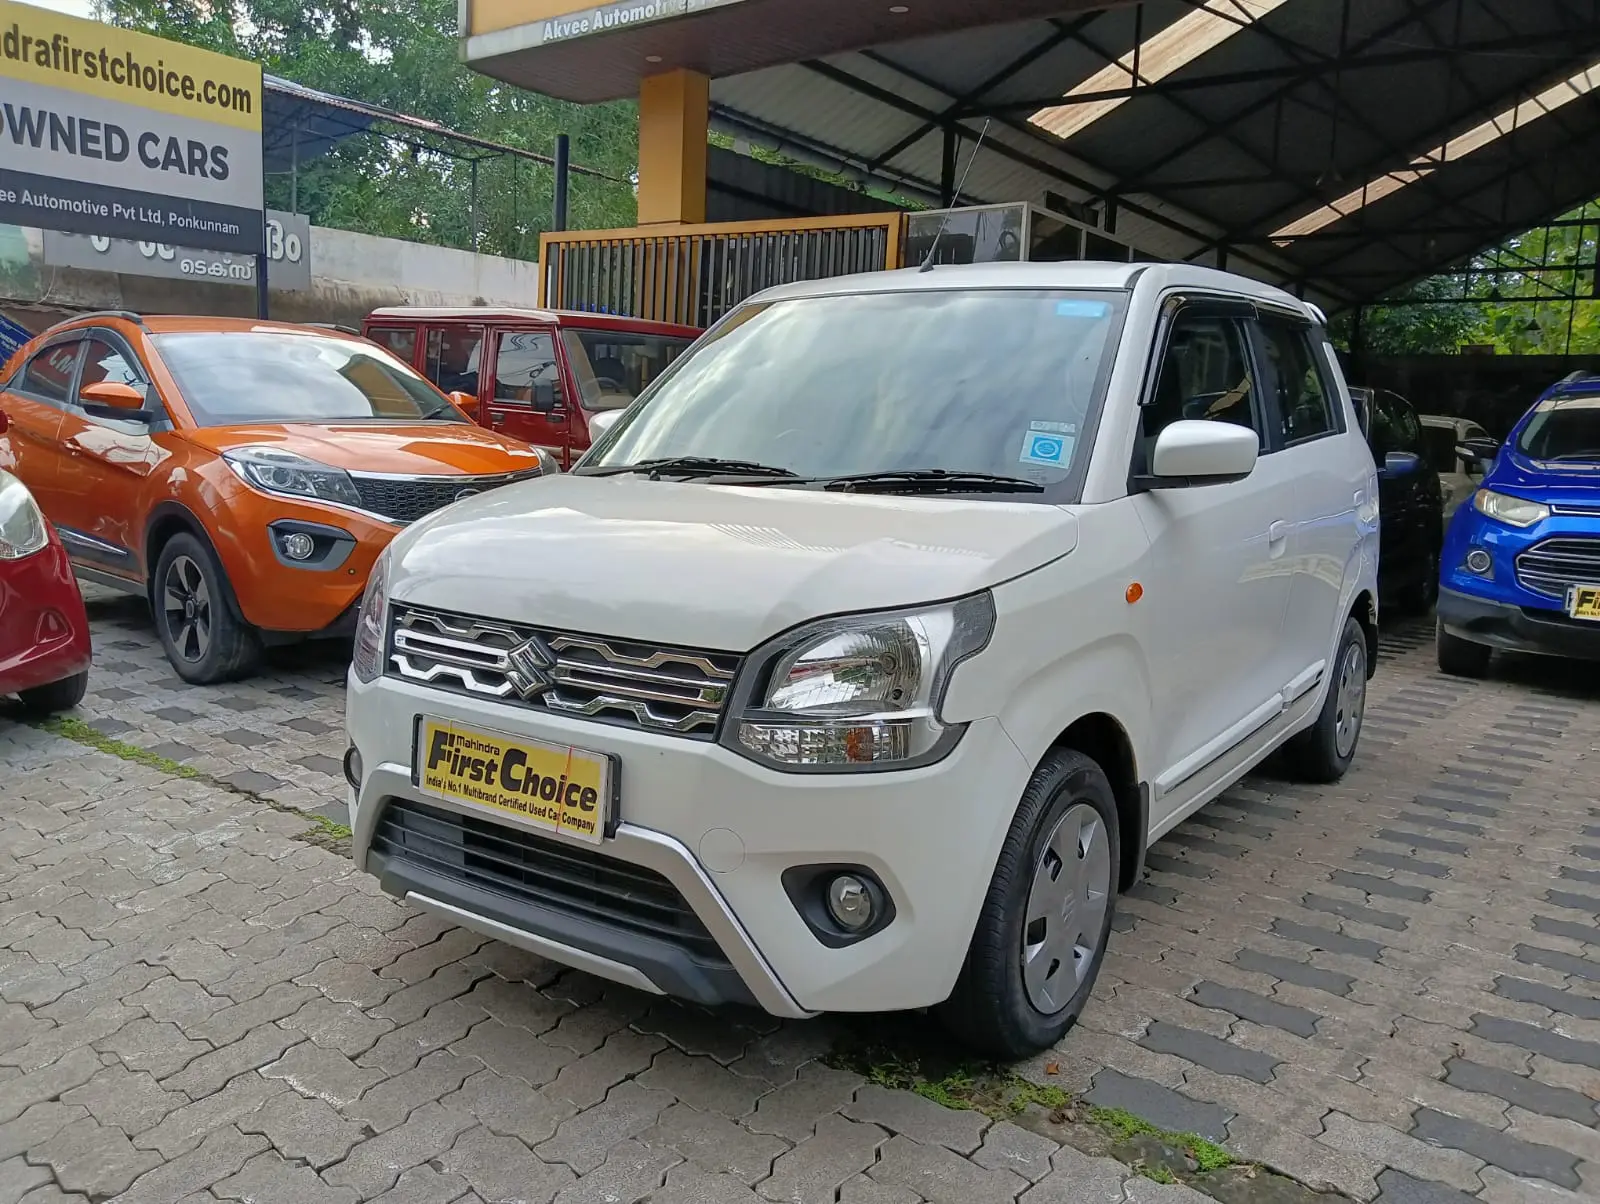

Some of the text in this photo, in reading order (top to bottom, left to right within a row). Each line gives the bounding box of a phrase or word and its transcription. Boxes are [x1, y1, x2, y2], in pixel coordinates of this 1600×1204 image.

[543, 18, 589, 41] Akvee
[0, 24, 251, 114] drafirstchoice.com
[0, 103, 229, 181] WNED CARS
[22, 190, 109, 216] Automotive
[113, 203, 136, 220] Pvt
[139, 208, 165, 228] Ltd,
[169, 212, 240, 235] Ponkunnam
[425, 774, 595, 834] India's No.1 Multibrand Certified Used Car Company
[427, 729, 598, 812] First Choice
